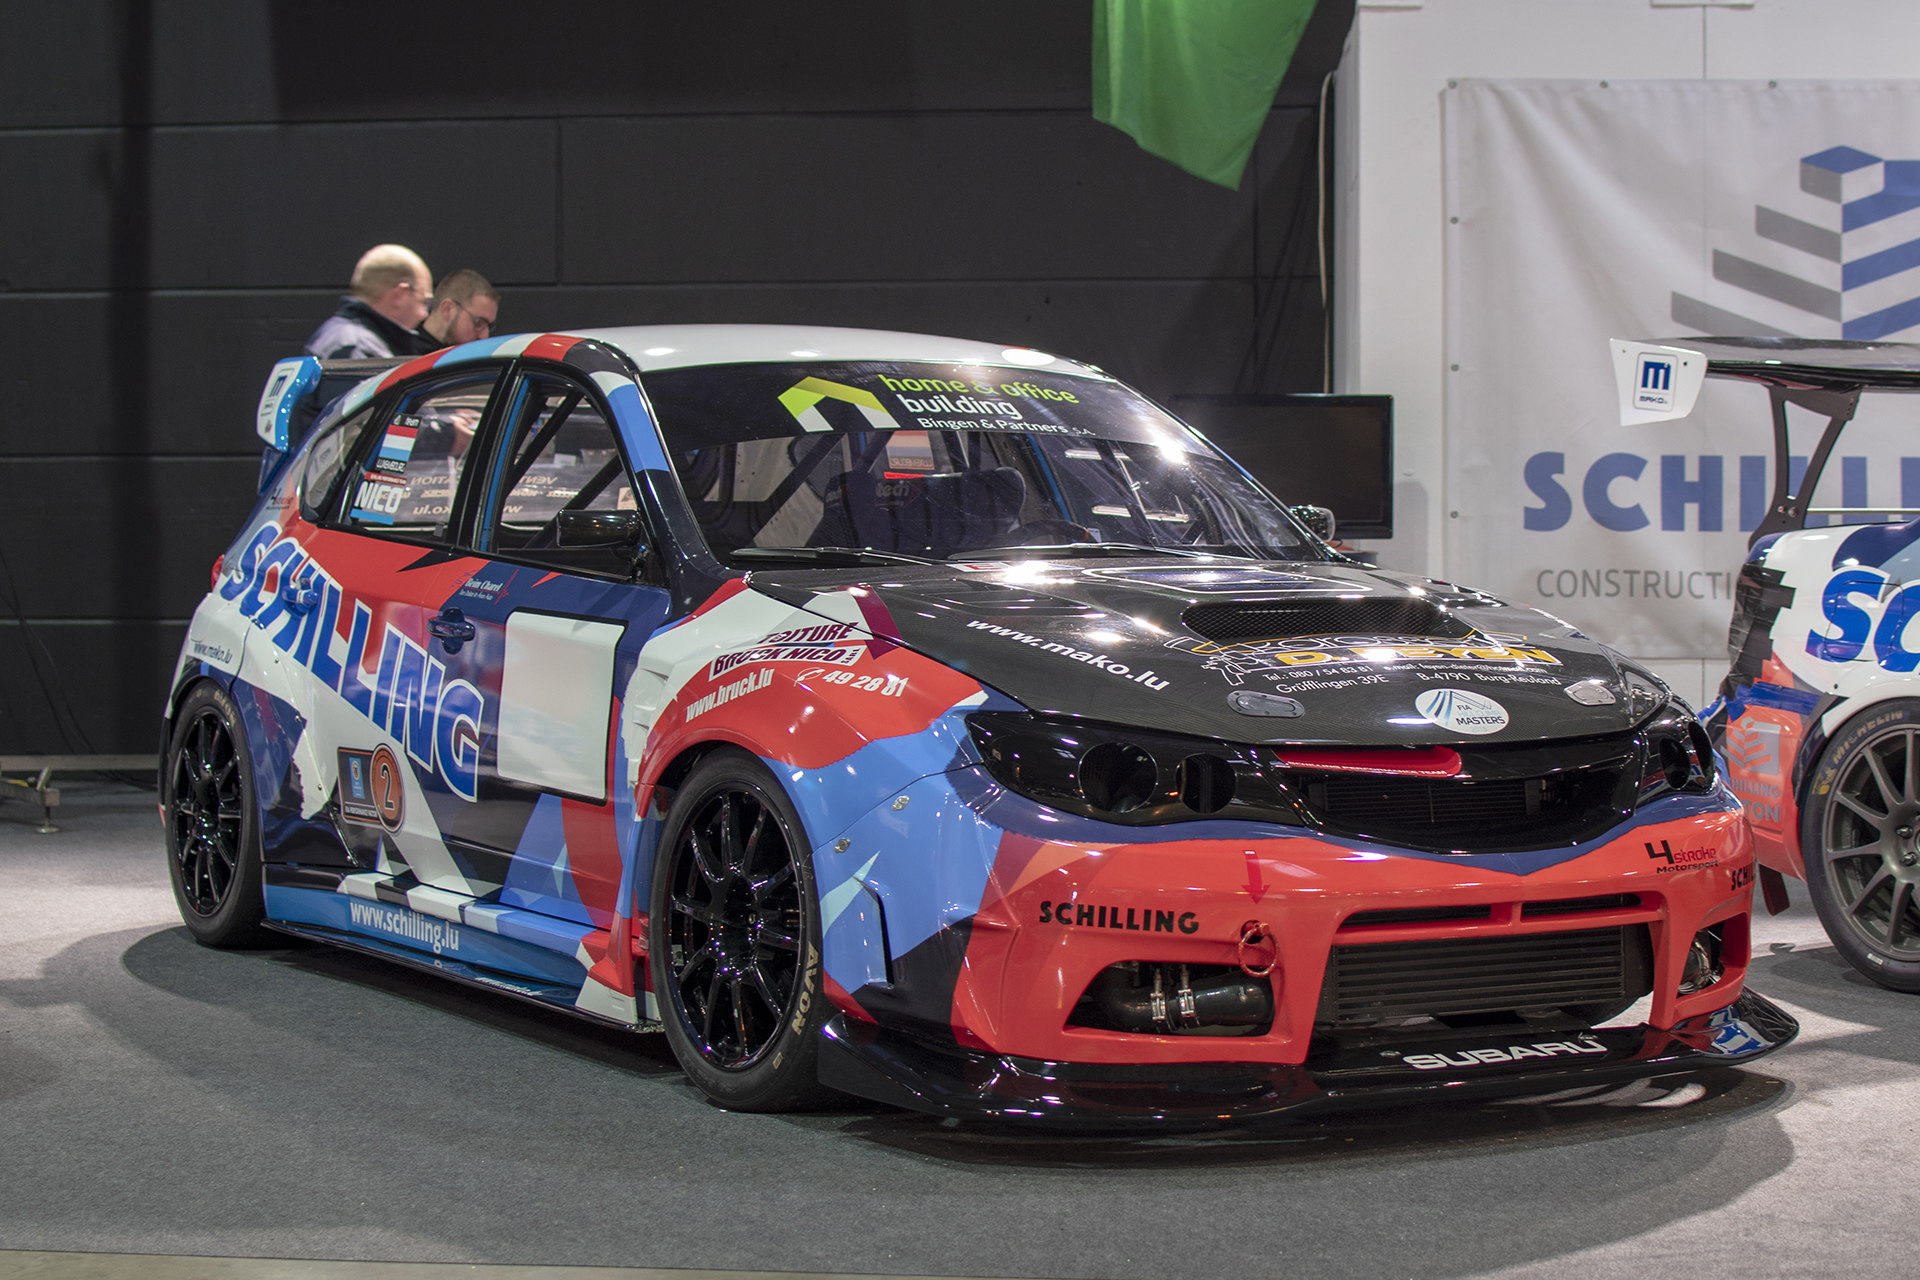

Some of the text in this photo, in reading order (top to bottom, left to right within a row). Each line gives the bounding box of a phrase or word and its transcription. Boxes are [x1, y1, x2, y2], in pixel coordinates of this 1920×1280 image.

[877, 374, 1080, 404] home & office
[896, 394, 1023, 421] building
[917, 417, 980, 430] Bingen
[980, 418, 996, 429] &
[994, 419, 1069, 434] Partners
[354, 480, 404, 514] NICO
[219, 520, 484, 803] SCHILLING
[712, 648, 790, 677] BRUCK
[782, 648, 847, 662] NICO
[966, 620, 1170, 691] www.mako.lu
[685, 668, 775, 723] www.bruck.lu
[822, 670, 853, 685] 49
[849, 675, 882, 692] 28
[1275, 672, 1562, 694] Grüfflingen 39E B-4790 Burg-Reuland
[1455, 716, 1506, 726] MASTERS
[380, 762, 396, 811] 2
[1656, 860, 1719, 874] Motorsport
[350, 902, 460, 954] www.schilling.lu
[1039, 900, 1200, 934] SCHILLING
[791, 941, 819, 1036] AVON
[1402, 1039, 1609, 1070] SUBARU
